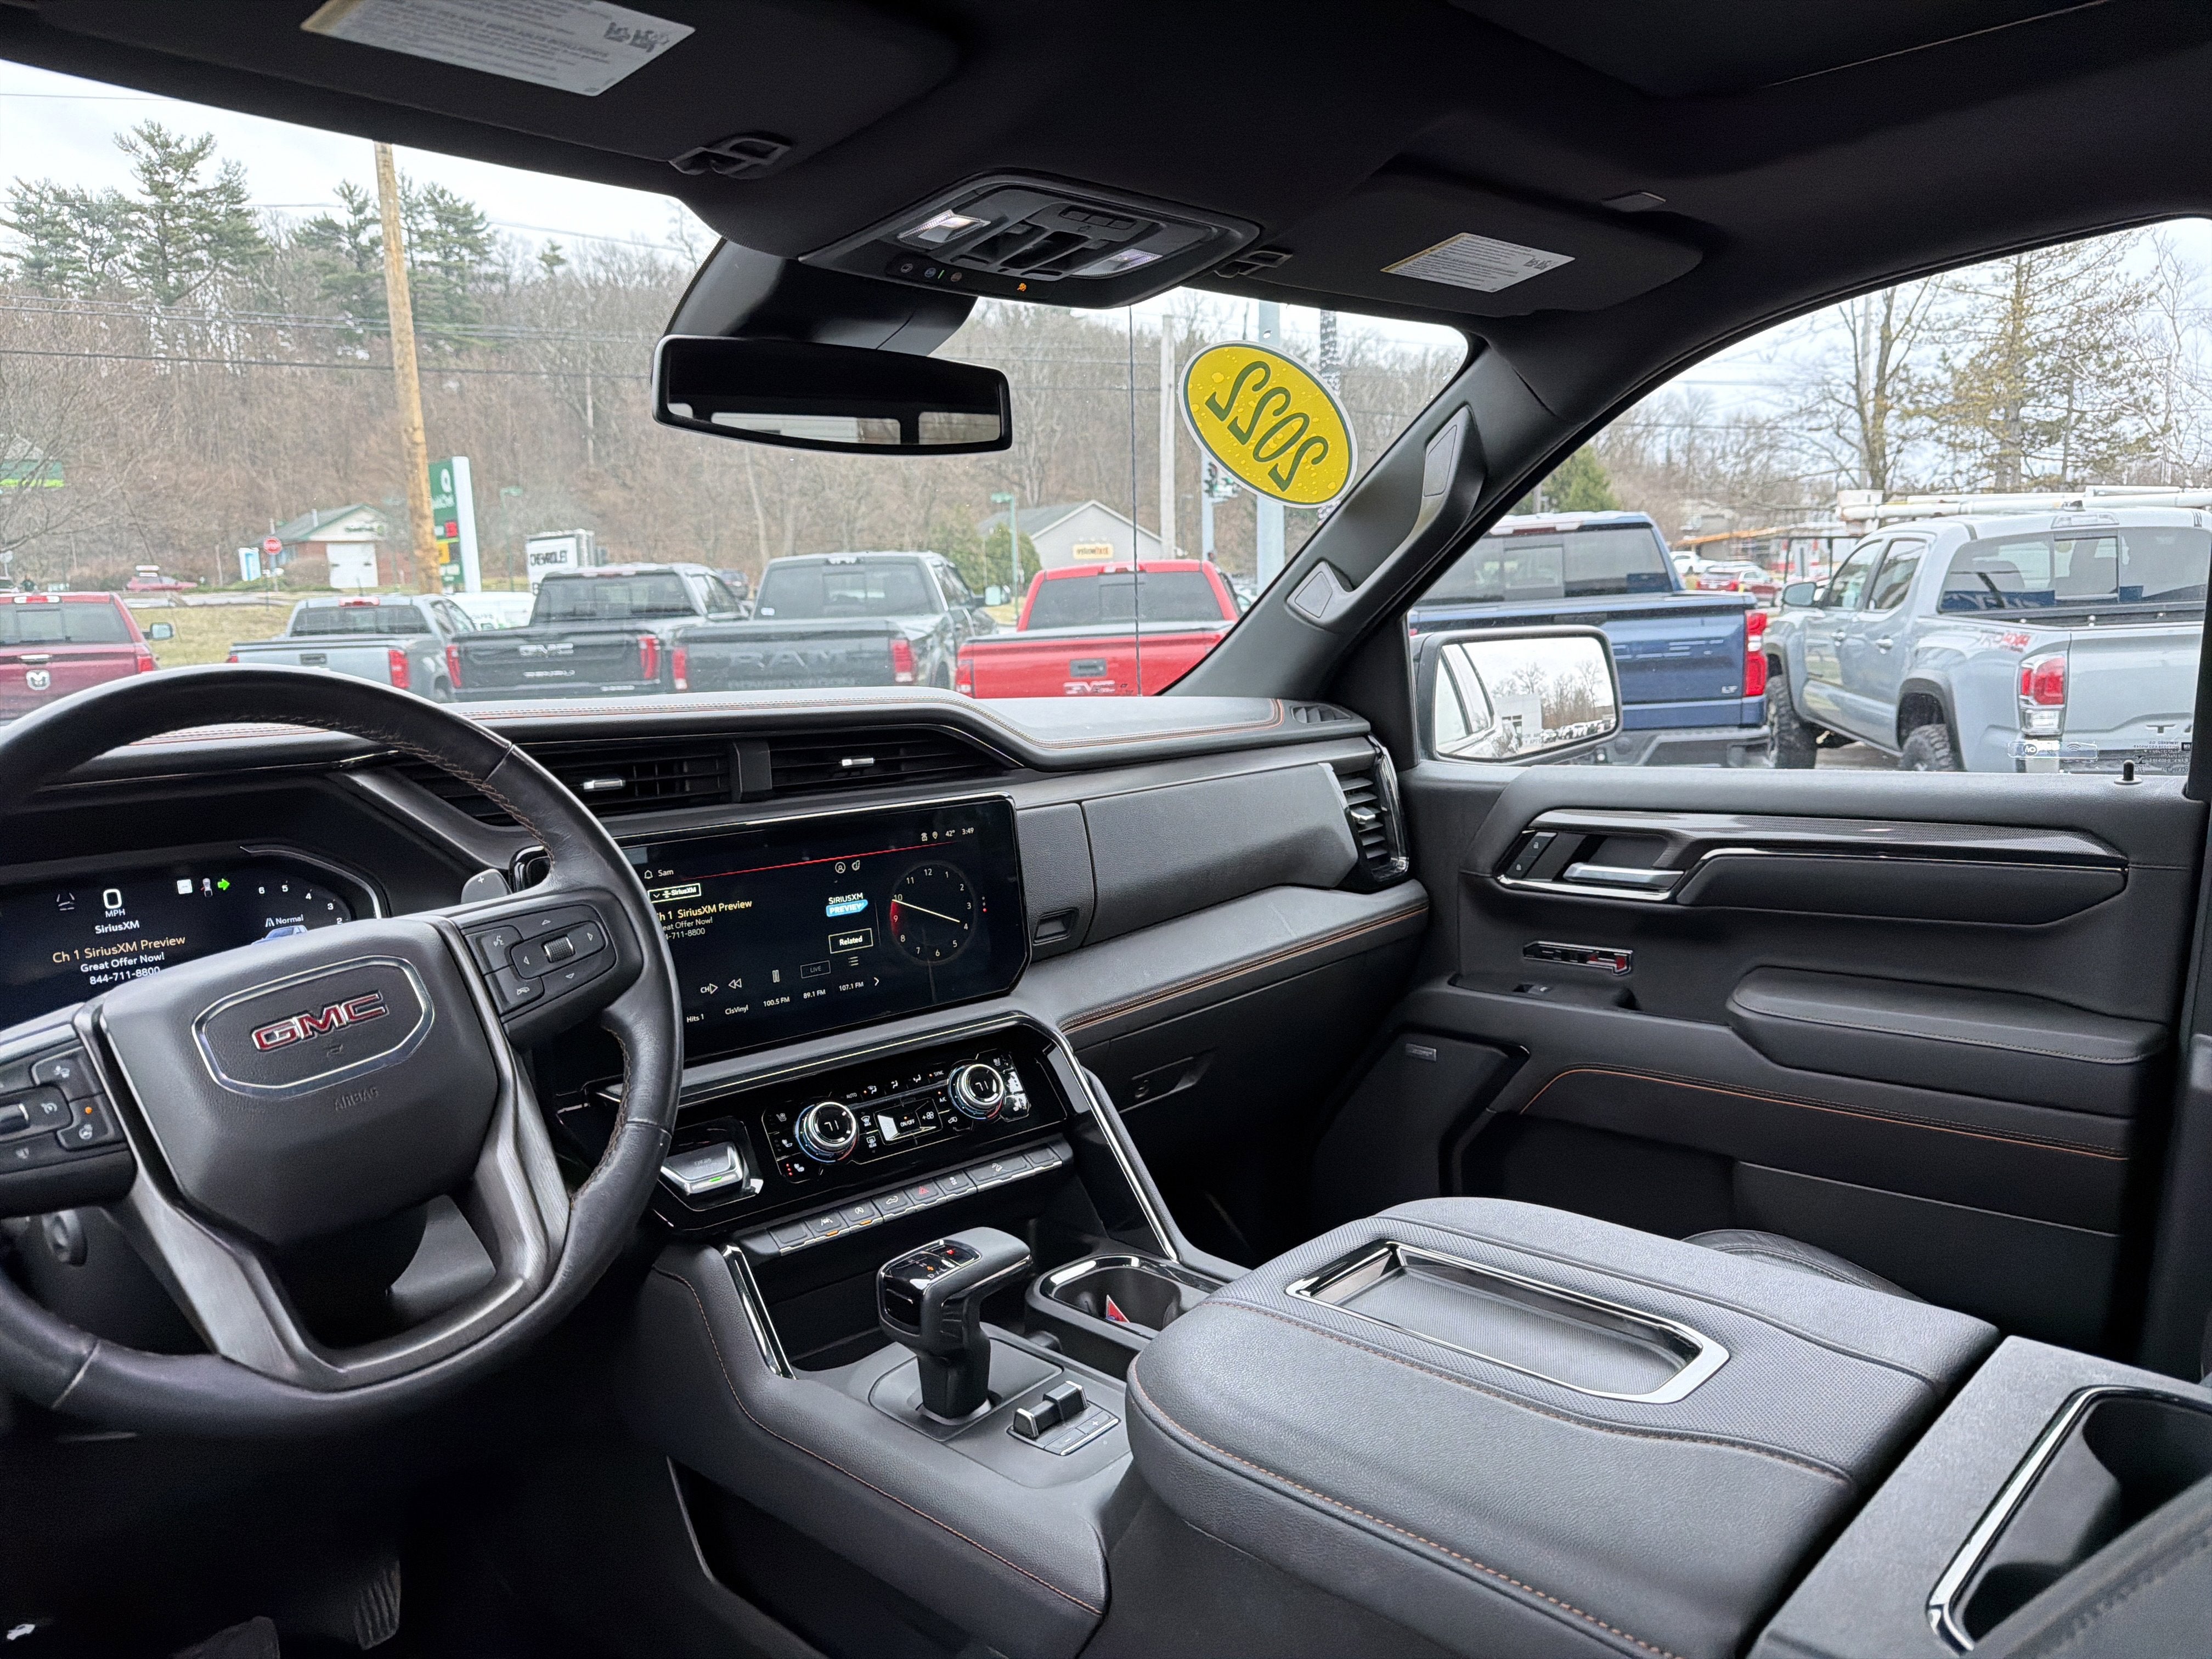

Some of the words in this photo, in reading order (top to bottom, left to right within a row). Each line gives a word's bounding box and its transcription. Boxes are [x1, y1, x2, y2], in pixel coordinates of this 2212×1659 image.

[962, 827, 974, 836] 3:49
[924, 868, 933, 877] 12
[906, 876, 915, 884] 11
[281, 884, 289, 893] 5
[103, 888, 122, 909] 0
[305, 892, 312, 900] 4
[828, 892, 864, 905] SIRIUSXM
[105, 909, 126, 918] MPH
[668, 910, 673, 920] 1
[678, 904, 717, 918] SiriusXM
[718, 900, 753, 912] Preview
[829, 903, 865, 915] PREVIEW
[275, 913, 304, 926] Normal
[675, 919, 693, 929] Offer
[695, 916, 713, 927] Now!
[94, 919, 140, 934] SiriusXM
[839, 935, 863, 946] Related
[52, 951, 70, 963] Ch
[74, 949, 80, 960] 1
[84, 941, 138, 959] SiriusXM
[140, 936, 186, 950] Preview
[80, 961, 110, 973] Great
[111, 957, 138, 968] Offer
[139, 951, 165, 963] Now!
[89, 966, 161, 985] 844-711-8800
[839, 983, 854, 992] 107.1
[803, 991, 815, 999] 89.1
[763, 998, 780, 1007] 100.5
[780, 996, 790, 1004] FM
[725, 1004, 749, 1015] ClsVinyl
[251, 991, 387, 1051] GMC
[686, 1015, 700, 1023] Hits
[900, 1119, 916, 1127] ON/OFF
